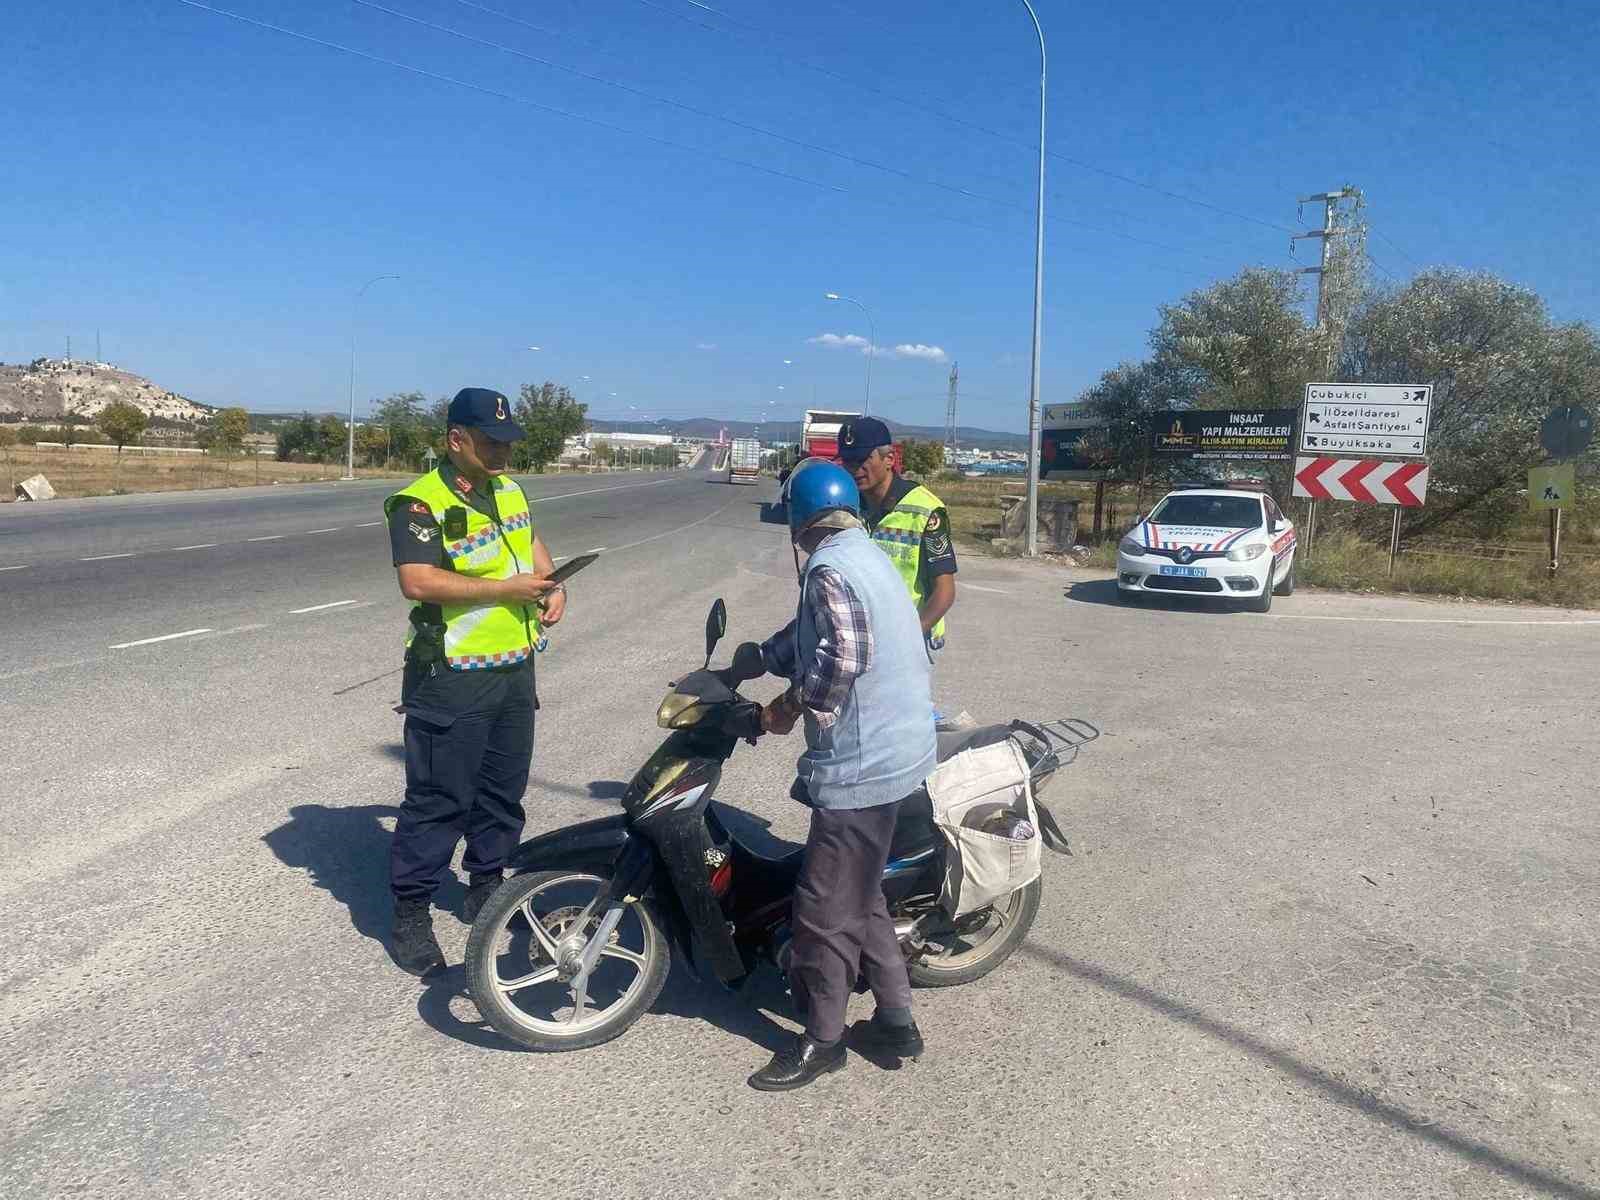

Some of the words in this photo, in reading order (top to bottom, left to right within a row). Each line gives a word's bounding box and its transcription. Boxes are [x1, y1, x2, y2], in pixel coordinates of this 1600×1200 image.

[1311, 390, 1367, 400] Çubukiçi
[1402, 391, 1410, 400] 3
[1230, 412, 1265, 426] İNŞAAT
[1202, 427, 1222, 436] YAPI
[1224, 424, 1291, 436] MALZEMELERİ
[1412, 441, 1420, 449] 4
